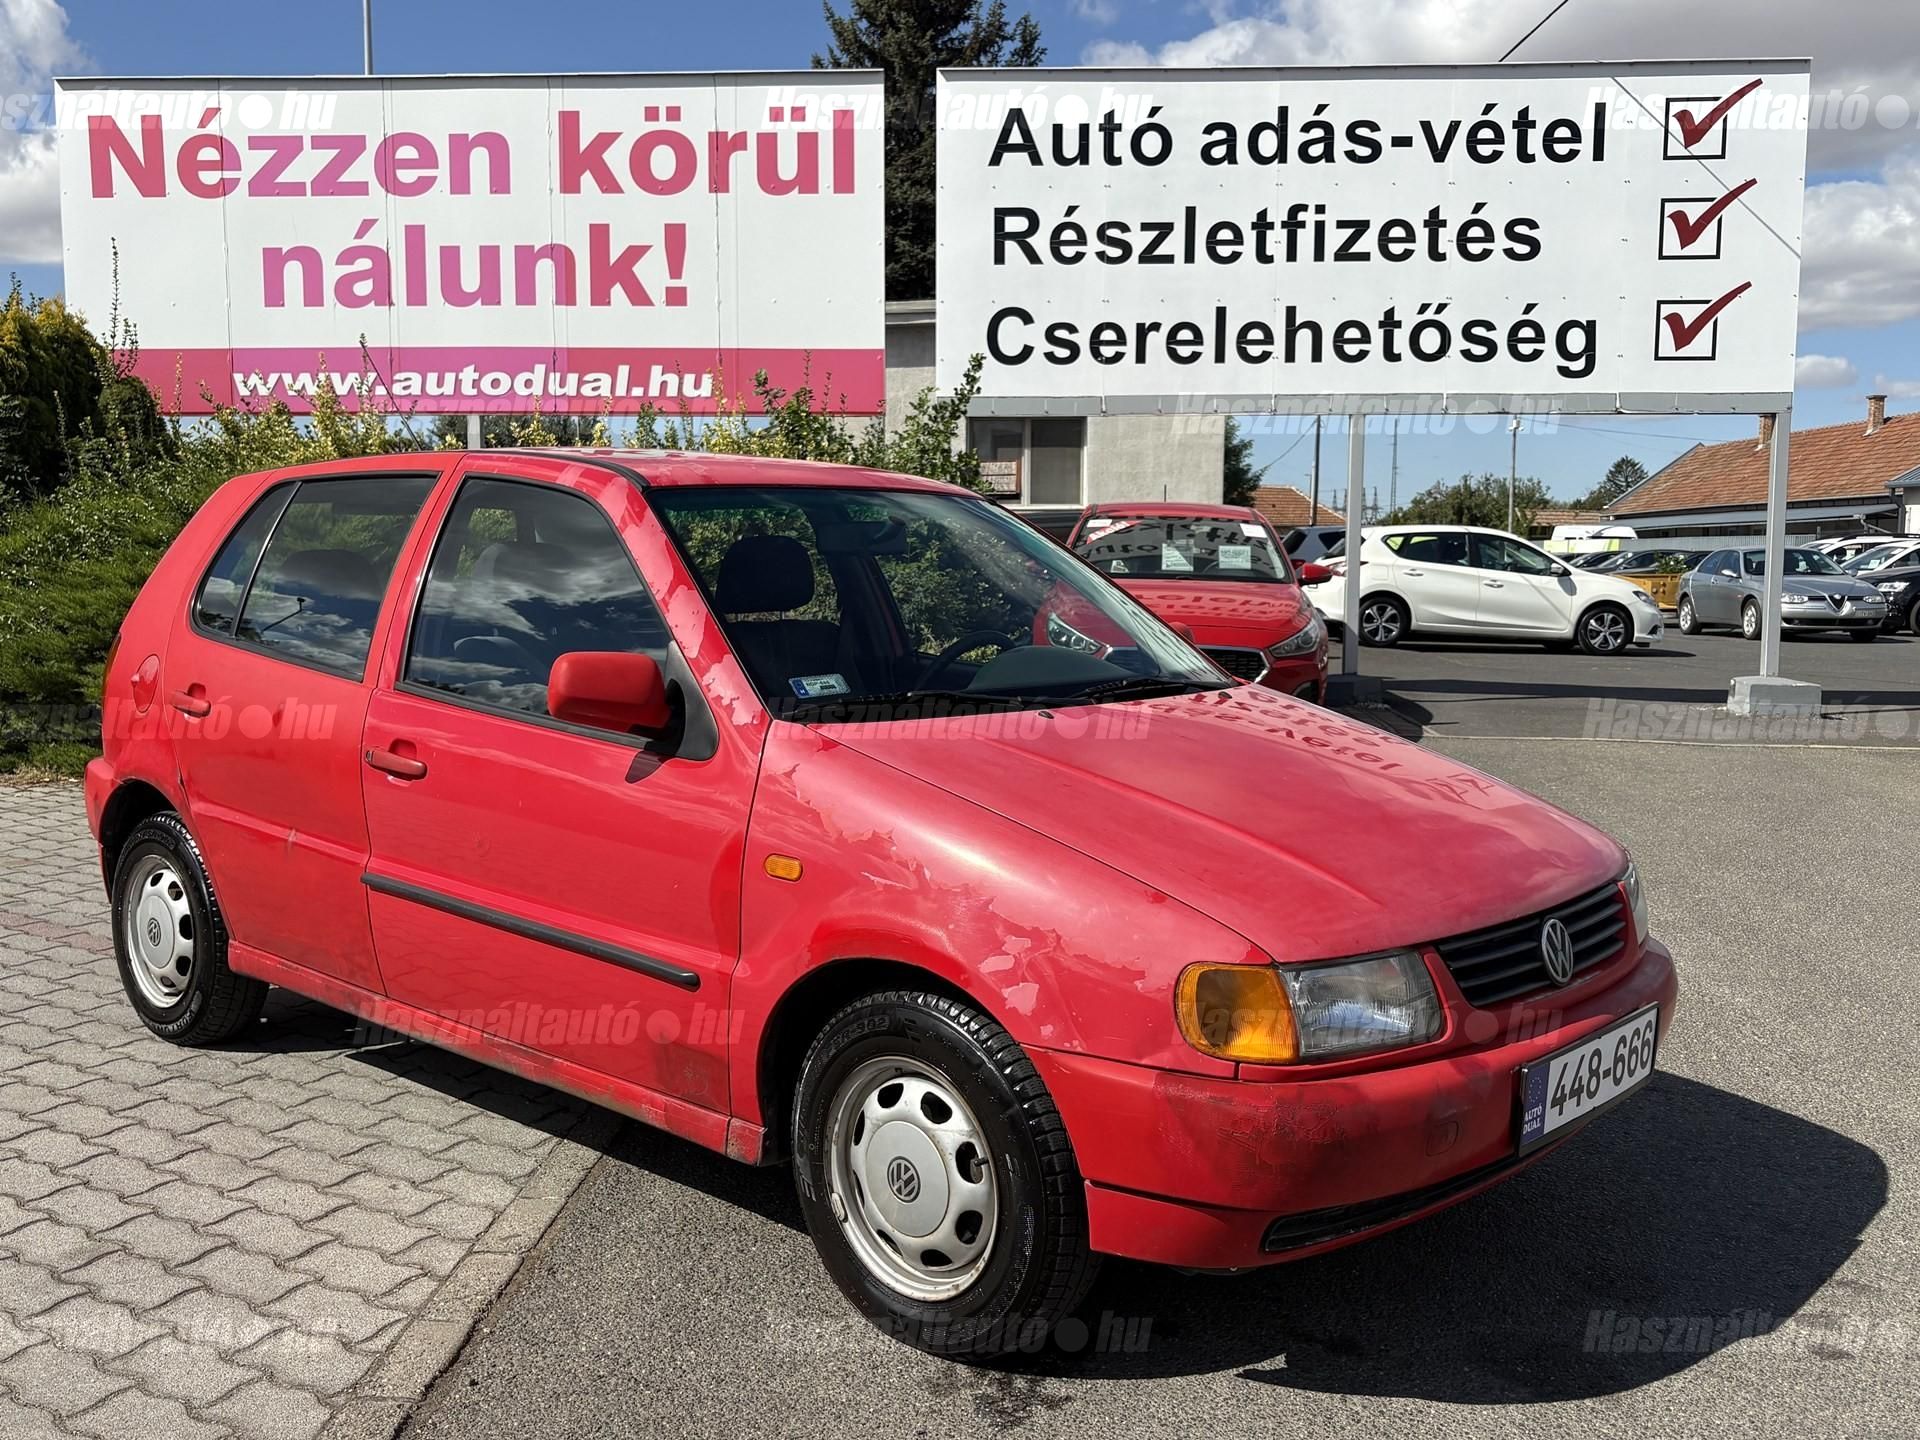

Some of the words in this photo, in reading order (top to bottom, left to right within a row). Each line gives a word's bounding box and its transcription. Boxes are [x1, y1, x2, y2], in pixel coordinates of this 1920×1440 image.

[87, 107, 511, 199] Nézzen
[558, 106, 856, 195] körül
[987, 105, 1174, 167] Autó
[1200, 102, 1606, 165] adás-vétel
[262, 218, 688, 307] nálunk!
[993, 202, 1542, 265] Részletfizetés
[986, 302, 1597, 379] Cserelehetőség
[233, 363, 713, 398] www.autodual.hu
[1550, 1019, 1653, 1116] 448-666
[1523, 1120, 1542, 1135] DUAL
[1524, 1104, 1543, 1121] AUTÓ
